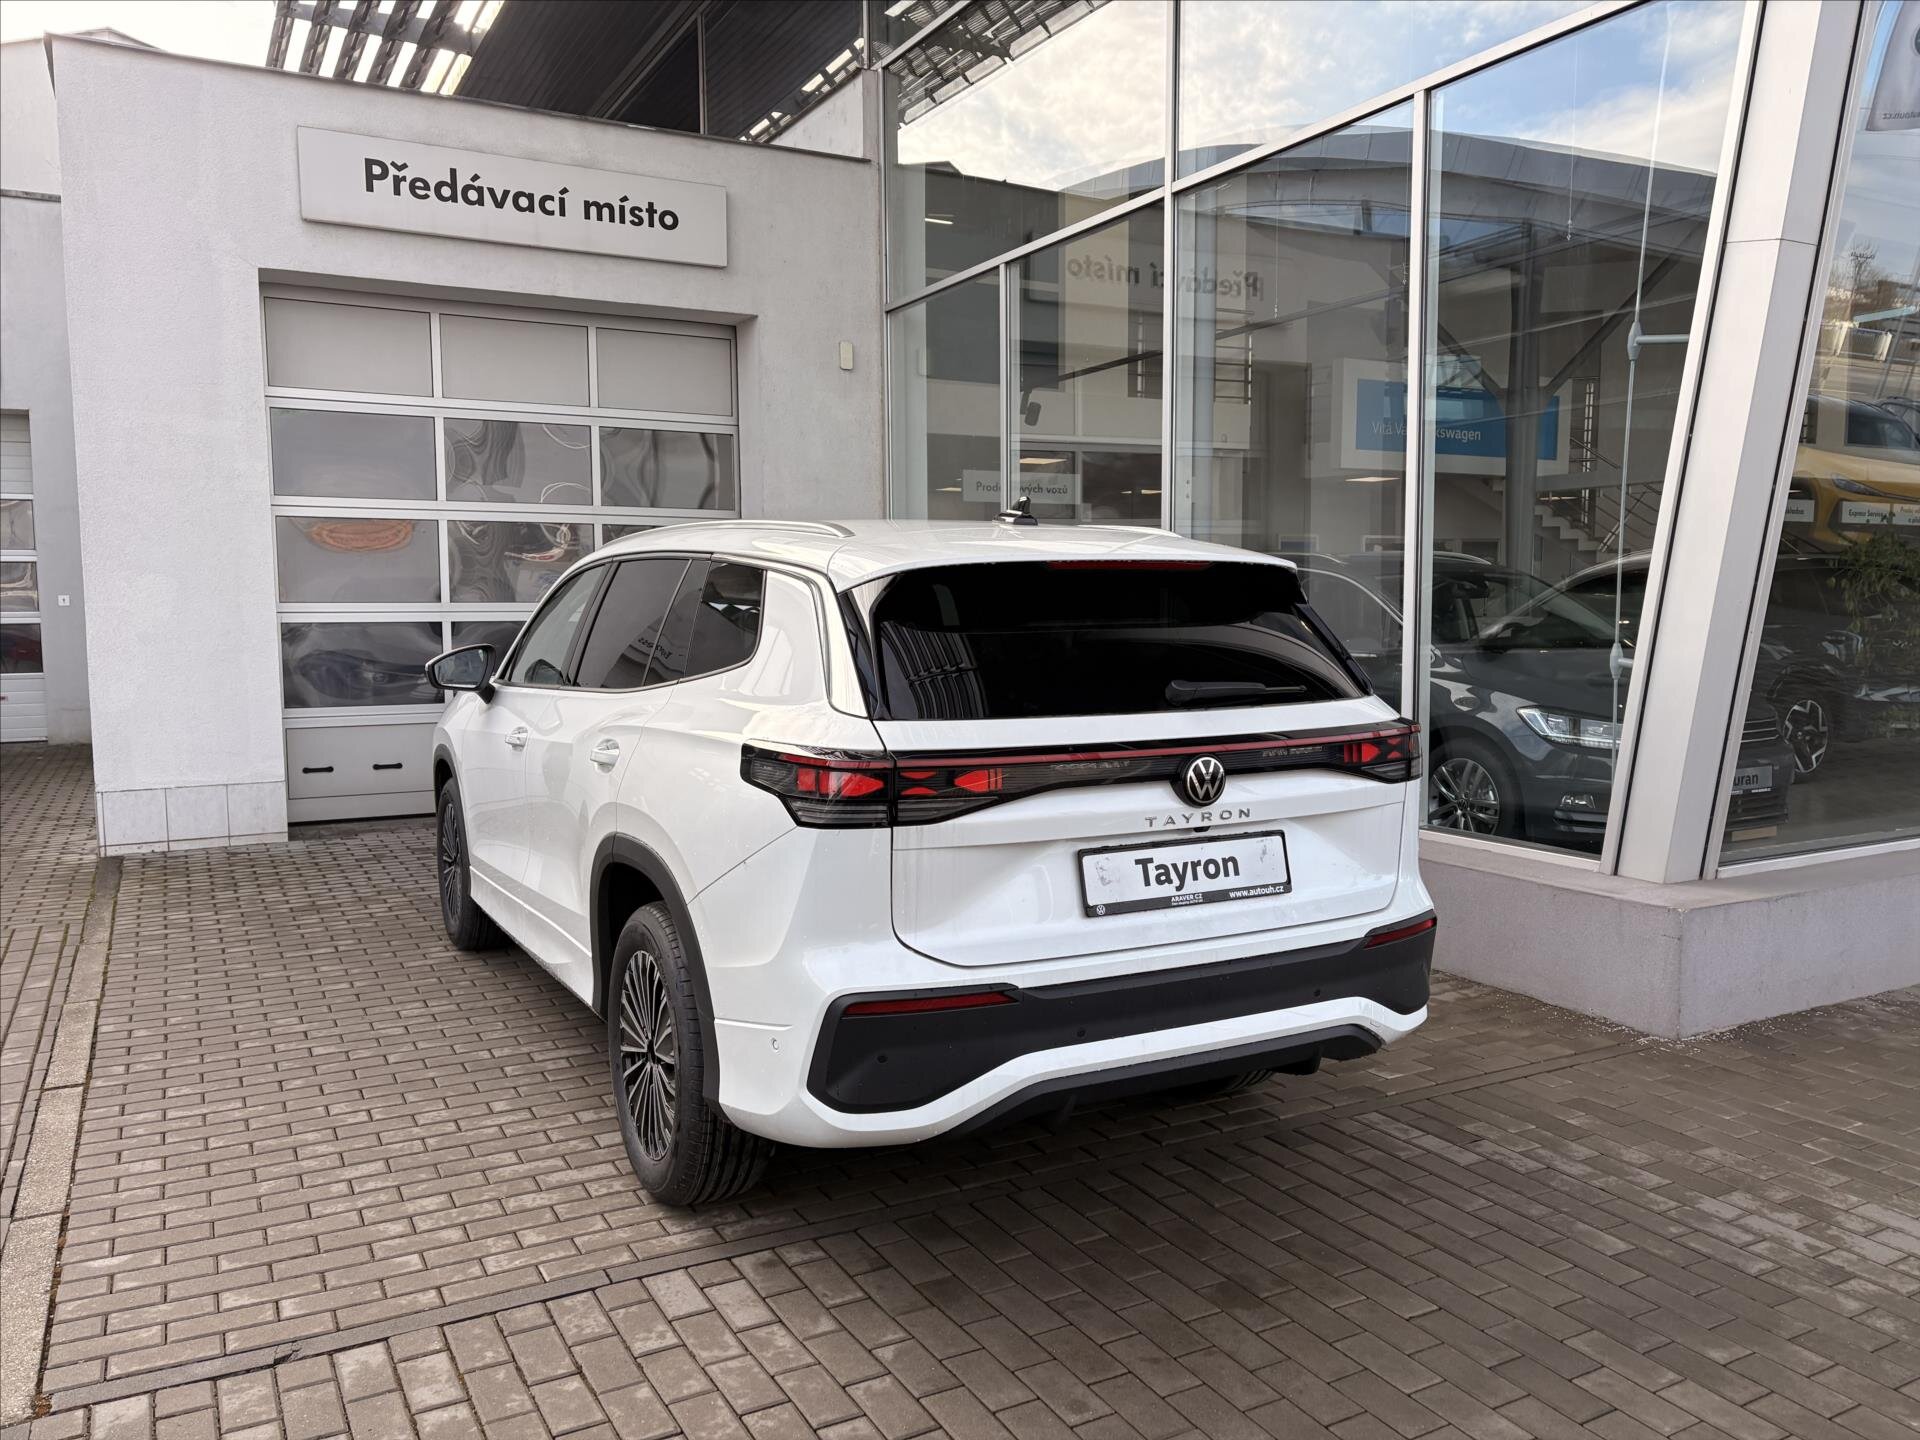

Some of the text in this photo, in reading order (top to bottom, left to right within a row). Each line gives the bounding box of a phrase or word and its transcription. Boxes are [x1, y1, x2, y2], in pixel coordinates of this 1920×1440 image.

[364, 157, 680, 231] Předávací místo
[1435, 426, 1481, 443] kswagen
[976, 481, 1001, 493] Prod
[1734, 774, 1759, 787] uran
[1145, 807, 1251, 828] TAYRON
[1134, 855, 1241, 892] Tayron
[1171, 894, 1194, 902] ARAVER
[1229, 884, 1285, 898] www.autouh.cz
